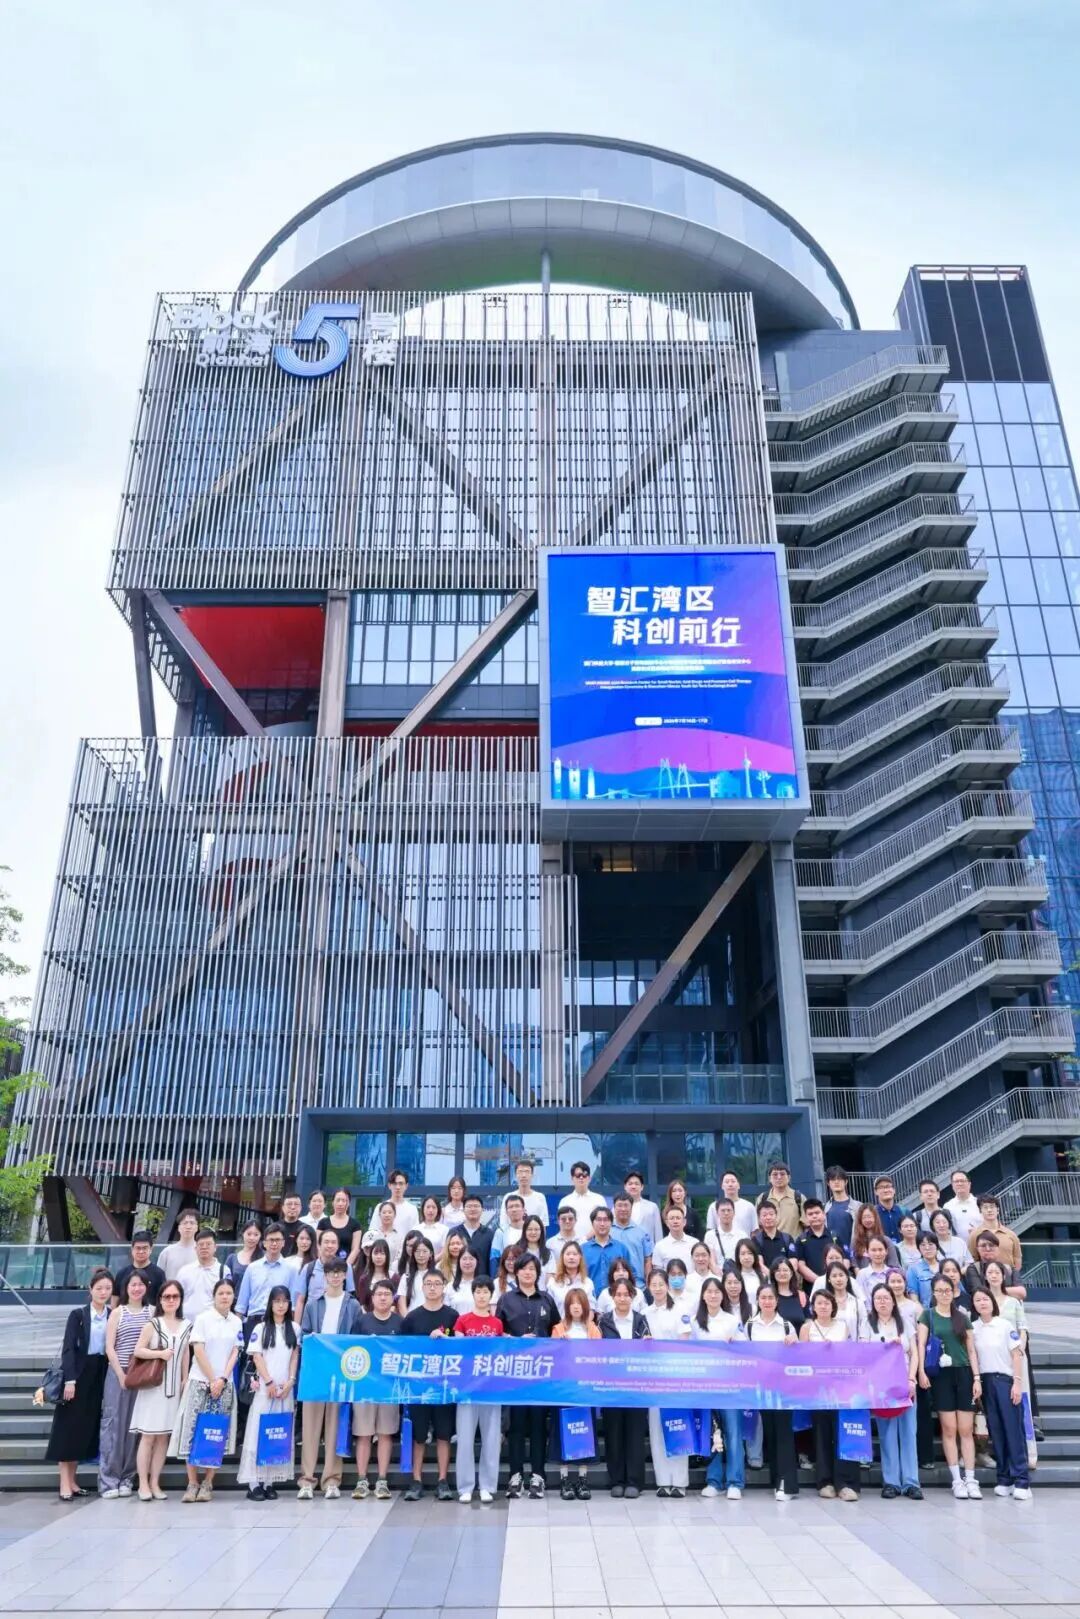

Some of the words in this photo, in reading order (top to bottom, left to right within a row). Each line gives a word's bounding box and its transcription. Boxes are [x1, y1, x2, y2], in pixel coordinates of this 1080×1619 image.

[171, 304, 280, 329] Block
[274, 302, 362, 379] 5
[196, 353, 270, 369] Qianhai
[587, 585, 714, 613] 智汇湾区
[612, 617, 741, 646] 科创前行
[380, 1352, 463, 1377] 智汇湾区
[472, 1354, 555, 1378] 科创前行
